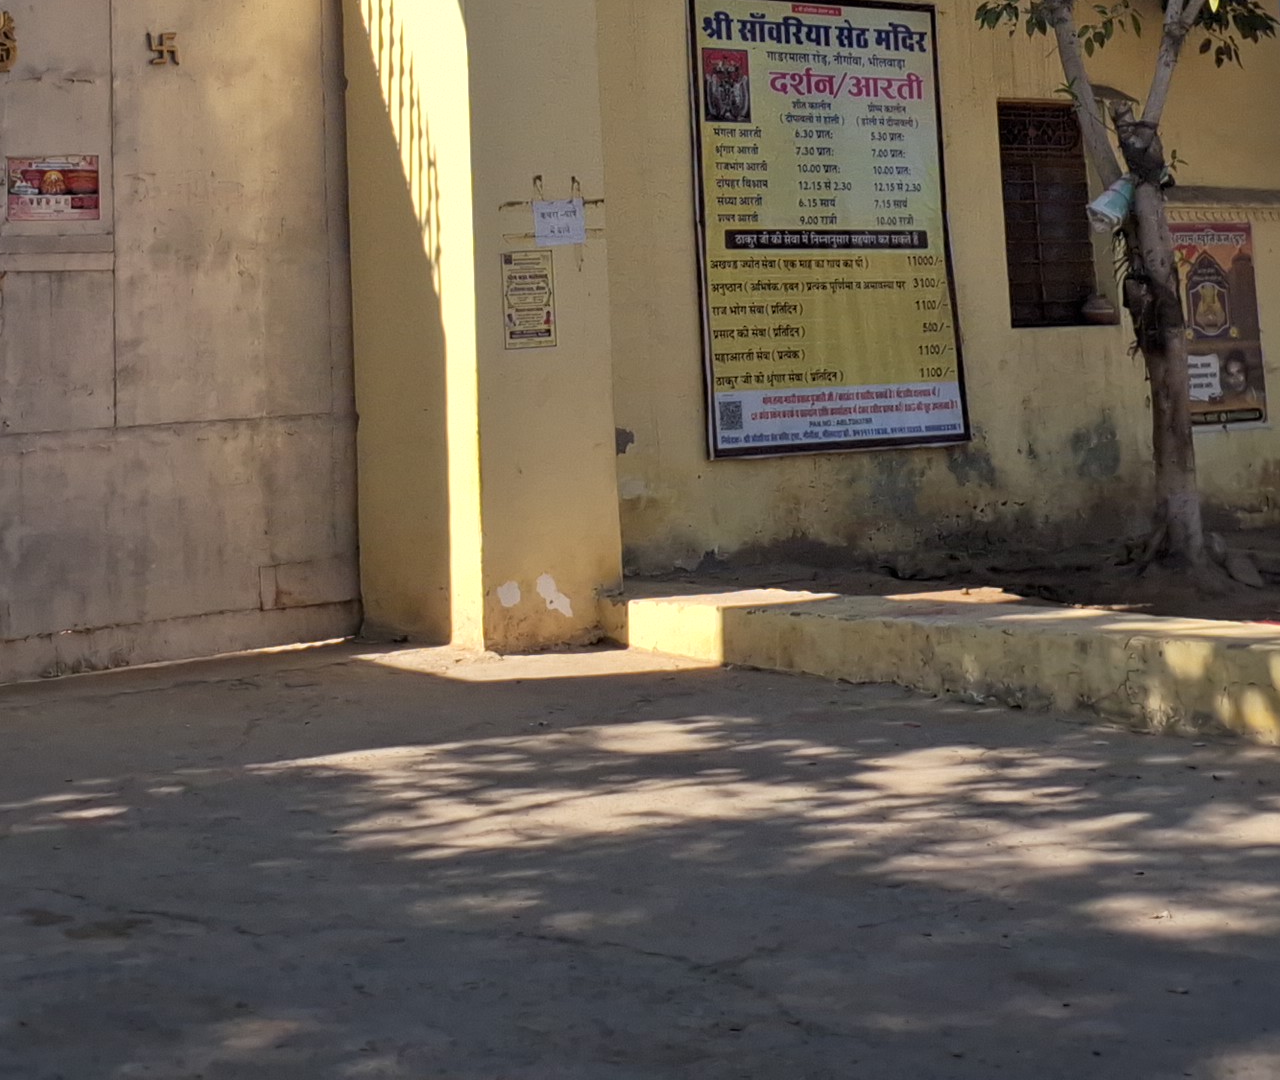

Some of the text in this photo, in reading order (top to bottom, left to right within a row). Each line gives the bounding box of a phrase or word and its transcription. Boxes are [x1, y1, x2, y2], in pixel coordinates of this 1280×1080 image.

[702, 11, 733, 41] श्री
[836, 19, 869, 49] सेठ
[874, 22, 928, 52] मंदिर
[713, 125, 762, 138] मंगला आरती
[795, 130, 814, 139] 6.30
[871, 132, 887, 141] 5.30
[737, 143, 759, 155] आरती
[795, 147, 815, 156] 7.30
[871, 149, 888, 158] 7.00
[746, 160, 768, 172] आरती
[797, 164, 820, 173] 10.00
[873, 166, 894, 175] 10.00
[798, 181, 822, 190] 12.15
[833, 182, 852, 191] 2.30
[874, 182, 895, 191] 12.15
[905, 183, 921, 192] 2.30
[739, 194, 762, 206] आरती
[799, 199, 817, 208] 6.15
[874, 200, 891, 209] 7.15
[800, 216, 818, 225] 9.00
[876, 216, 897, 226] 10.00
[735, 234, 757, 248] ठाकुर
[759, 231, 770, 244] जी
[784, 231, 800, 244] सेवा
[801, 231, 810, 244] में
[851, 232, 877, 245] सहयोग
[878, 234, 889, 245] कर
[891, 232, 911, 244] सकते
[762, 256, 776, 269] सेवा
[799, 259, 812, 270] माह
[907, 255, 943, 267] 11000/-
[896, 281, 907, 290] पर
[913, 278, 946, 289] 3100/-
[712, 306, 727, 316] राज
[729, 303, 746, 316] भोग
[748, 304, 764, 315] सेवा
[915, 300, 948, 311] 1100/-
[713, 329, 735, 340] प्रसाद
[751, 325, 766, 338] सेवा
[923, 322, 951, 333] 500/-
[918, 344, 954, 356] 1100/-
[714, 348, 754, 364] महाआरती
[756, 348, 770, 360] सेवा
[920, 367, 955, 378] 1100/-
[716, 375, 738, 389] ठाकुर
[740, 372, 752, 384] जी
[788, 370, 803, 381] सेवा
